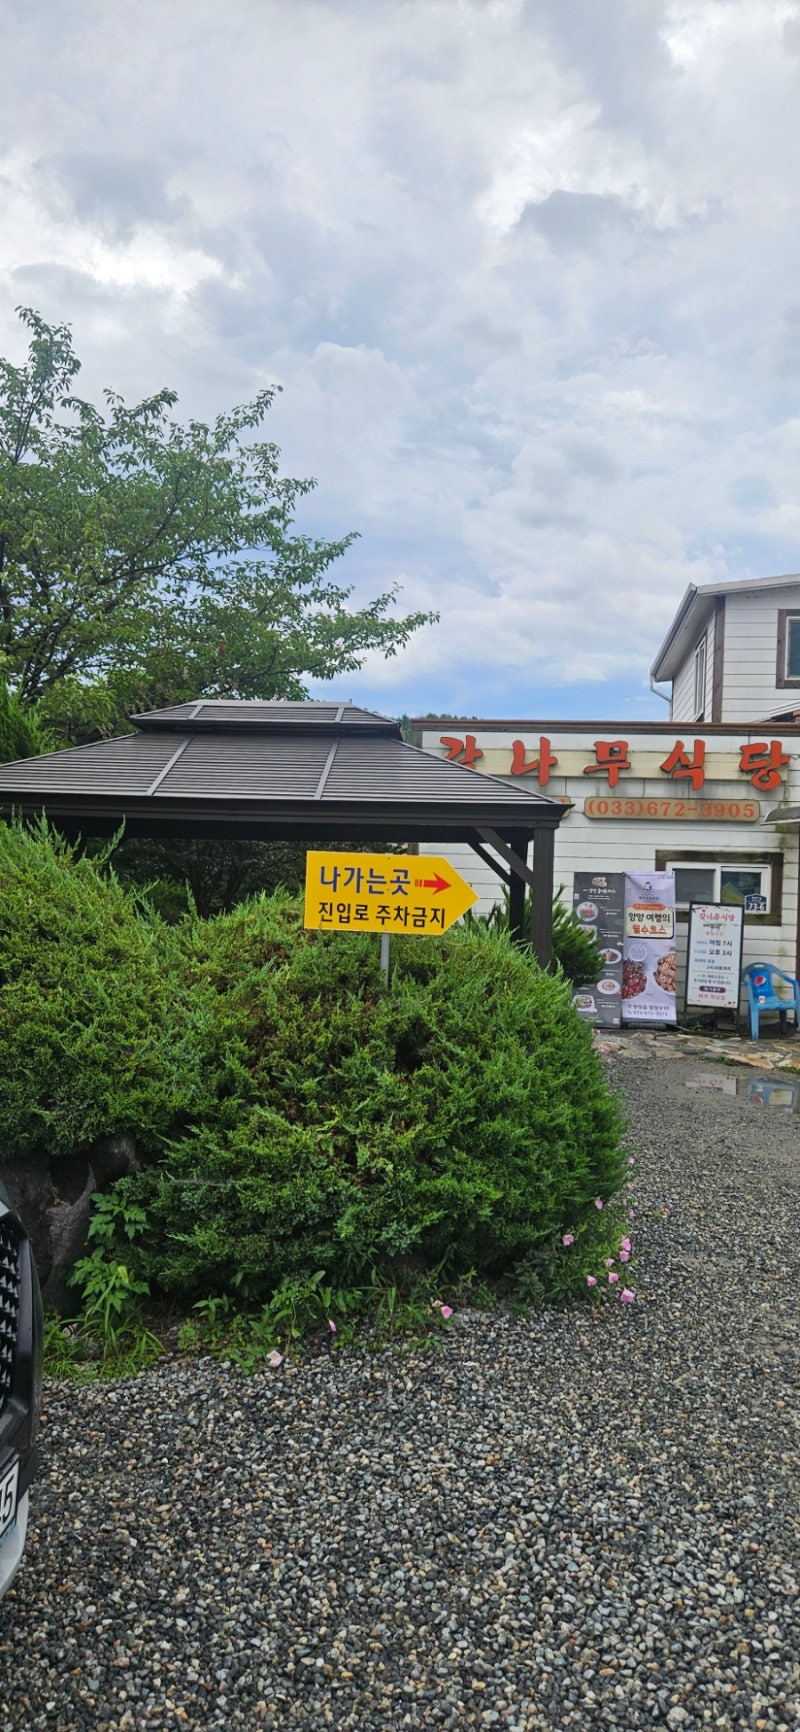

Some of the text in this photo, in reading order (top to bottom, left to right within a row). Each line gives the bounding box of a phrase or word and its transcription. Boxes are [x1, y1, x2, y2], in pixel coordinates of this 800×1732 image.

[588, 799, 756, 818] (033)672-3905
[320, 866, 411, 896] 나가는곳
[318, 902, 446, 928] 진입로 주차금지
[749, 902, 765, 911] 73-6
[628, 912, 671, 923] 양양 여행의
